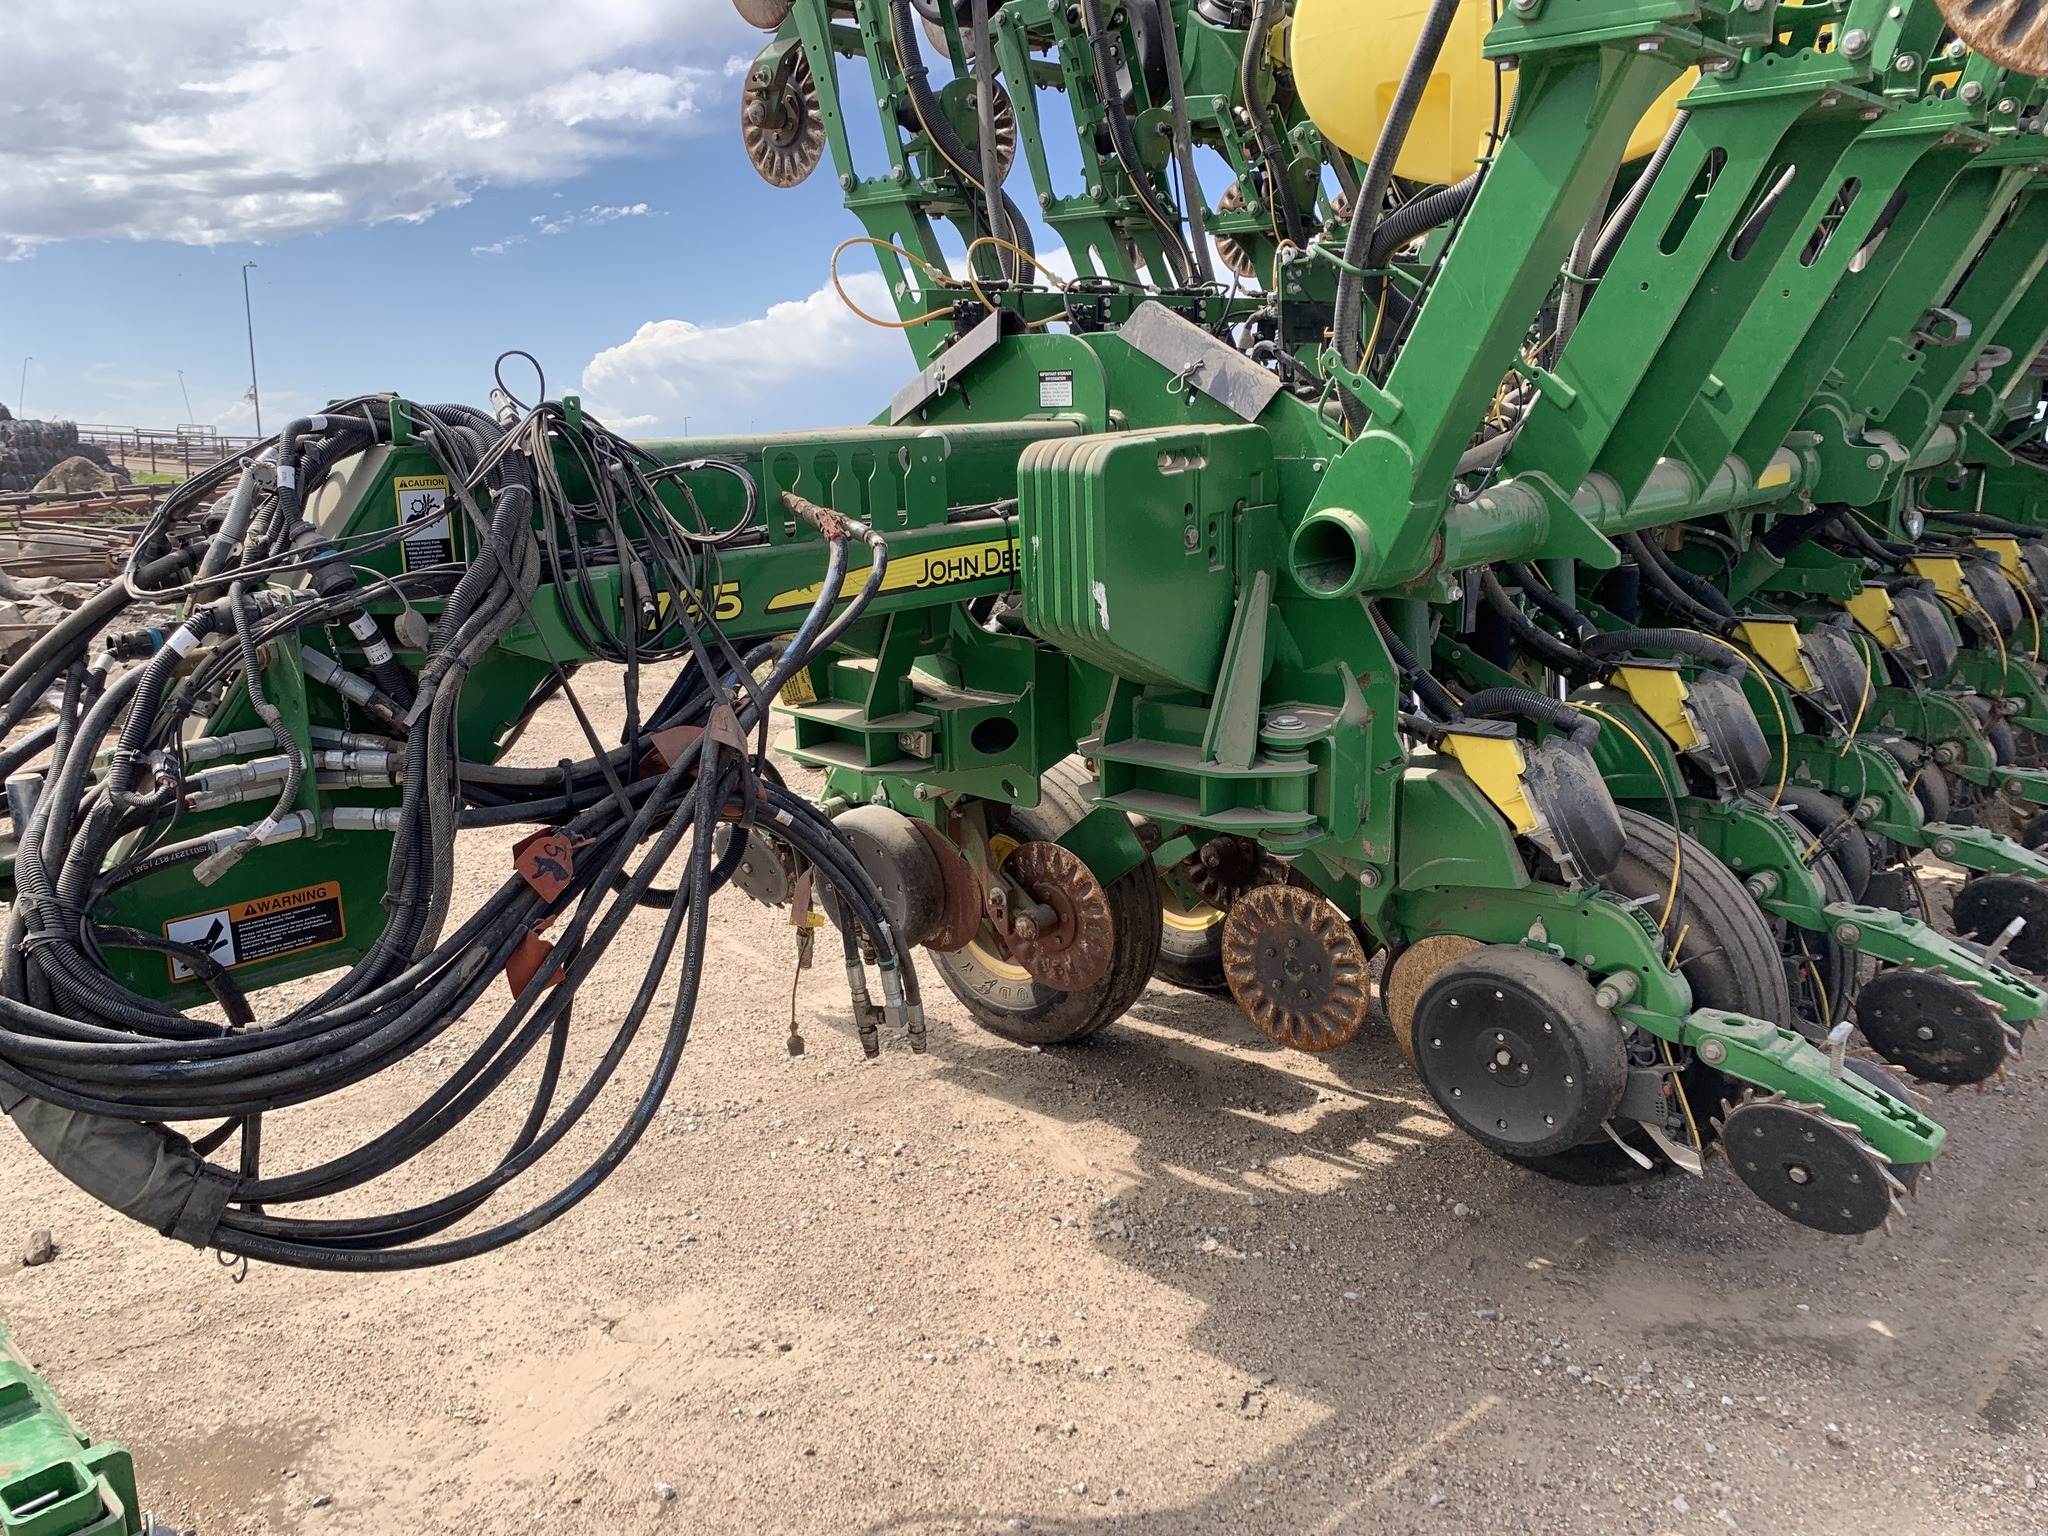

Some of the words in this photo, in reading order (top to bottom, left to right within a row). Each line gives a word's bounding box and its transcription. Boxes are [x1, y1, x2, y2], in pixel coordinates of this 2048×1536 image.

[408, 479, 444, 487] CAUTION
[916, 555, 980, 585] JOHN
[618, 580, 744, 632] 795
[134, 864, 149, 874] SAE
[155, 857, 169, 866] R17
[257, 887, 327, 912] WARNING
